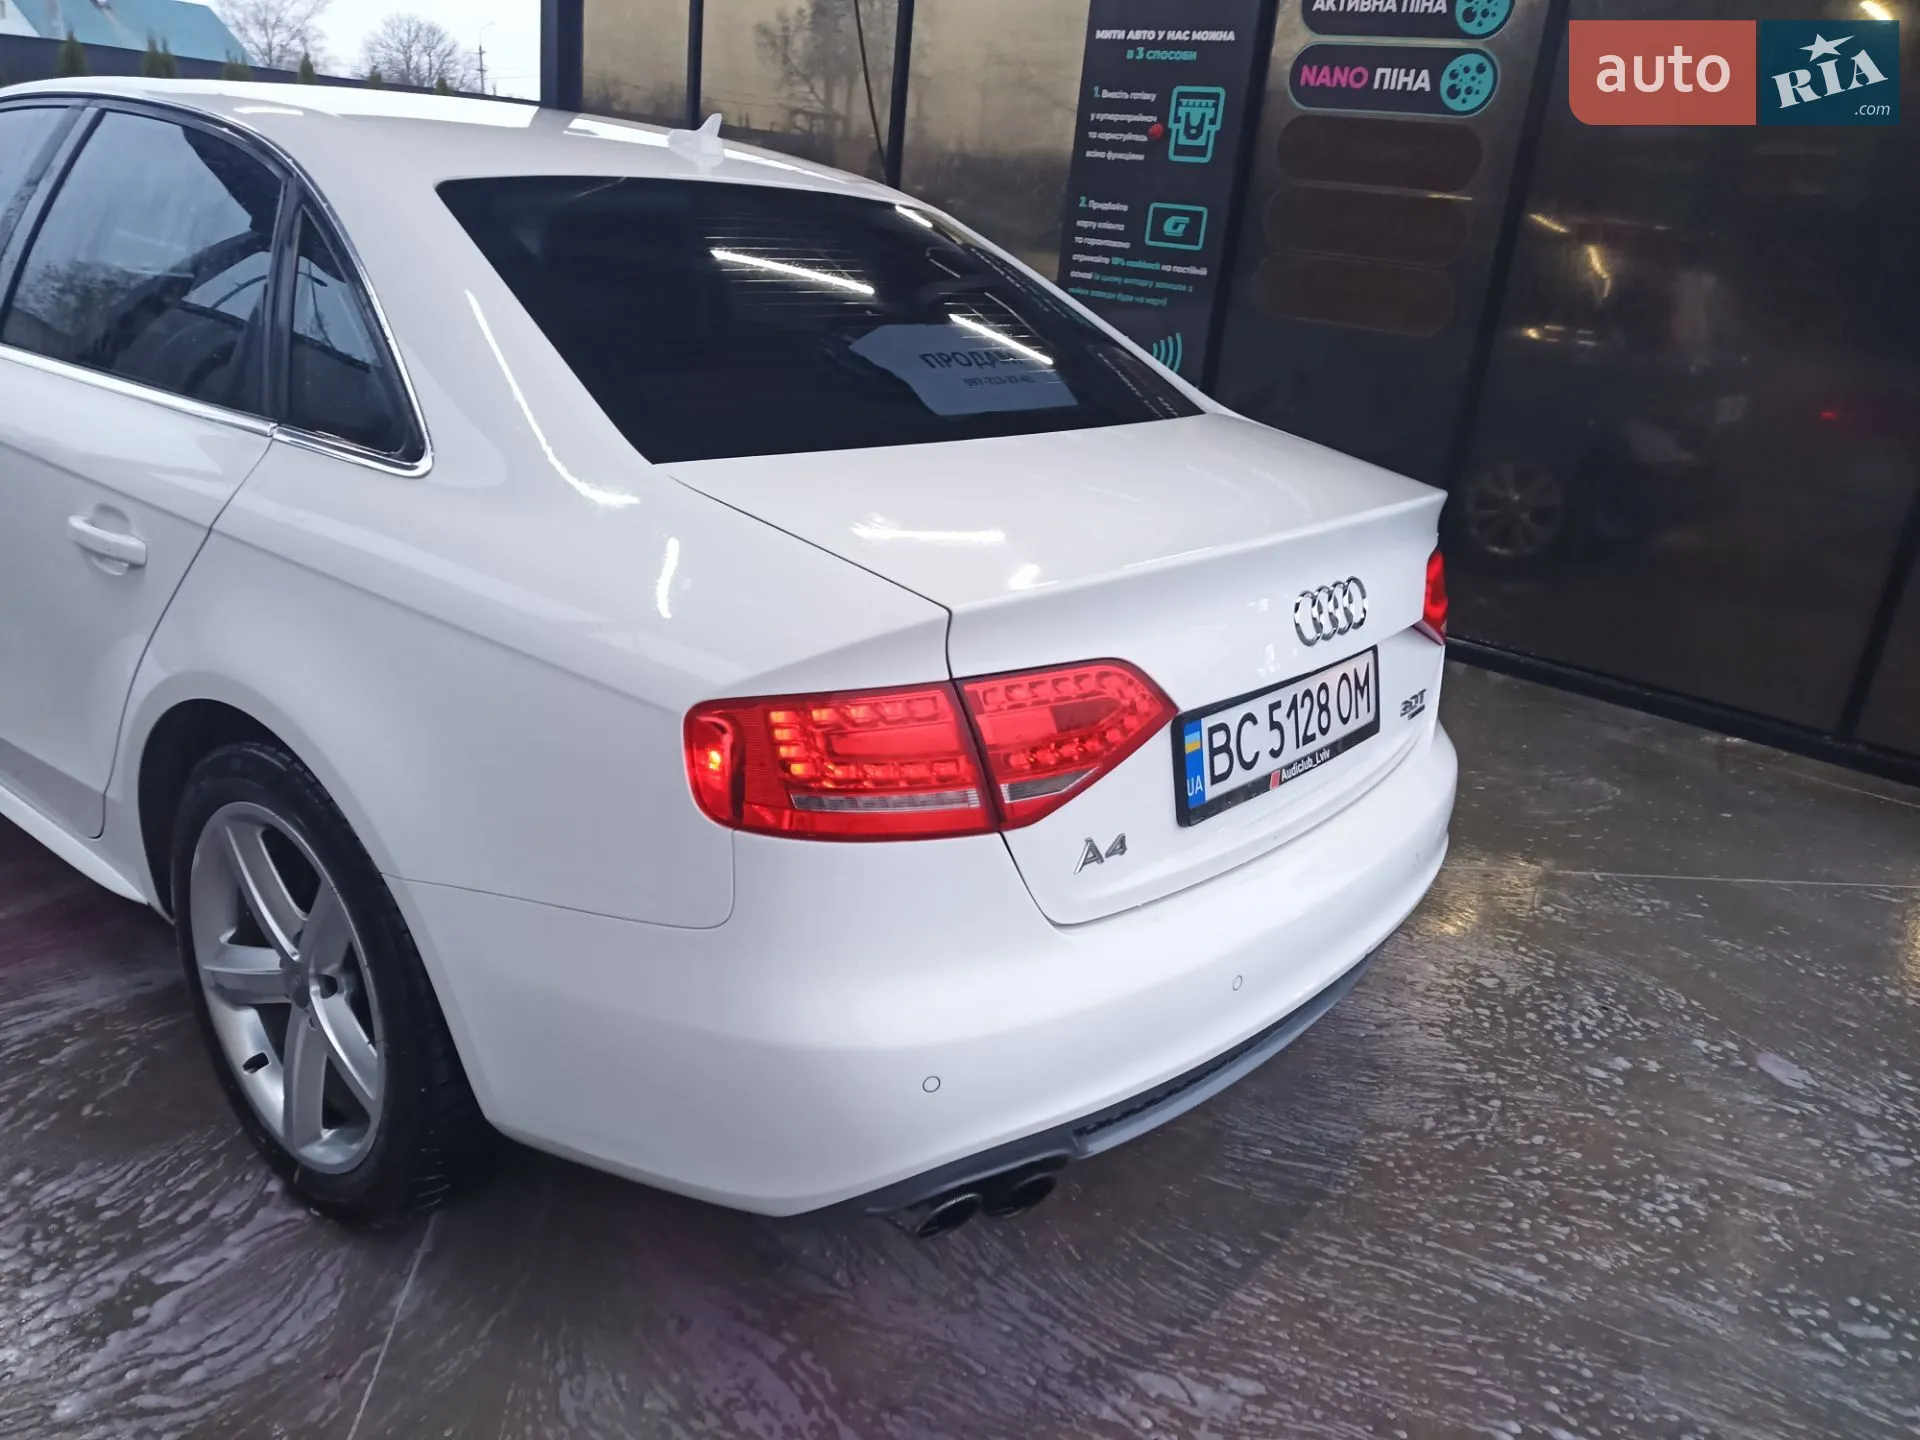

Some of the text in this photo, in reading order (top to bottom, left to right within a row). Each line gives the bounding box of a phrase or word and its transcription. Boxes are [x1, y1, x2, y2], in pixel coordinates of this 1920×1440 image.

[1095, 29, 1236, 42] МИТИ АВТО У НАС МОЖНА
[1136, 47, 1145, 59] 3
[1300, 64, 1432, 92] NANO ПІНА
[1207, 662, 1371, 786] BC 5128 OM
[1186, 776, 1204, 797] UA
[1073, 832, 1127, 875] A4
